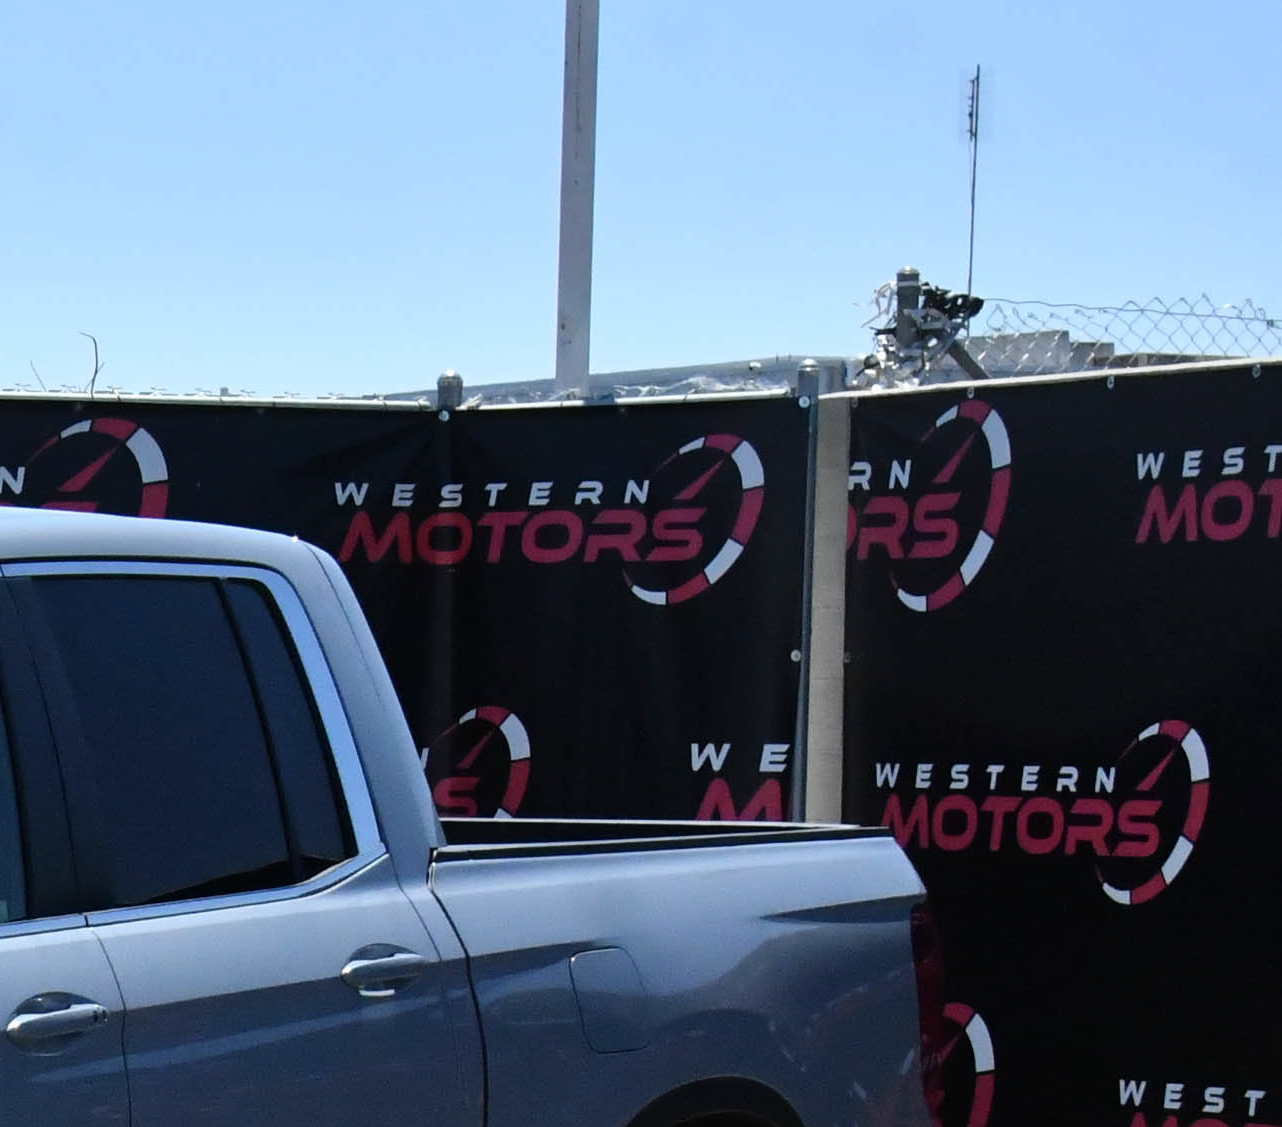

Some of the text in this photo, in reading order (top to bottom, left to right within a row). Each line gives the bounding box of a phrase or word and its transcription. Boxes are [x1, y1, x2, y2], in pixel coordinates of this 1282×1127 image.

[1137, 444, 1282, 481] WEST
[335, 479, 650, 508] WESTERN
[1136, 478, 1282, 543] MOT
[339, 507, 707, 565] MOTORS
[875, 763, 1116, 794] WESTERN
[882, 793, 1163, 858] MOTORS
[1119, 1078, 1267, 1117] WEST
